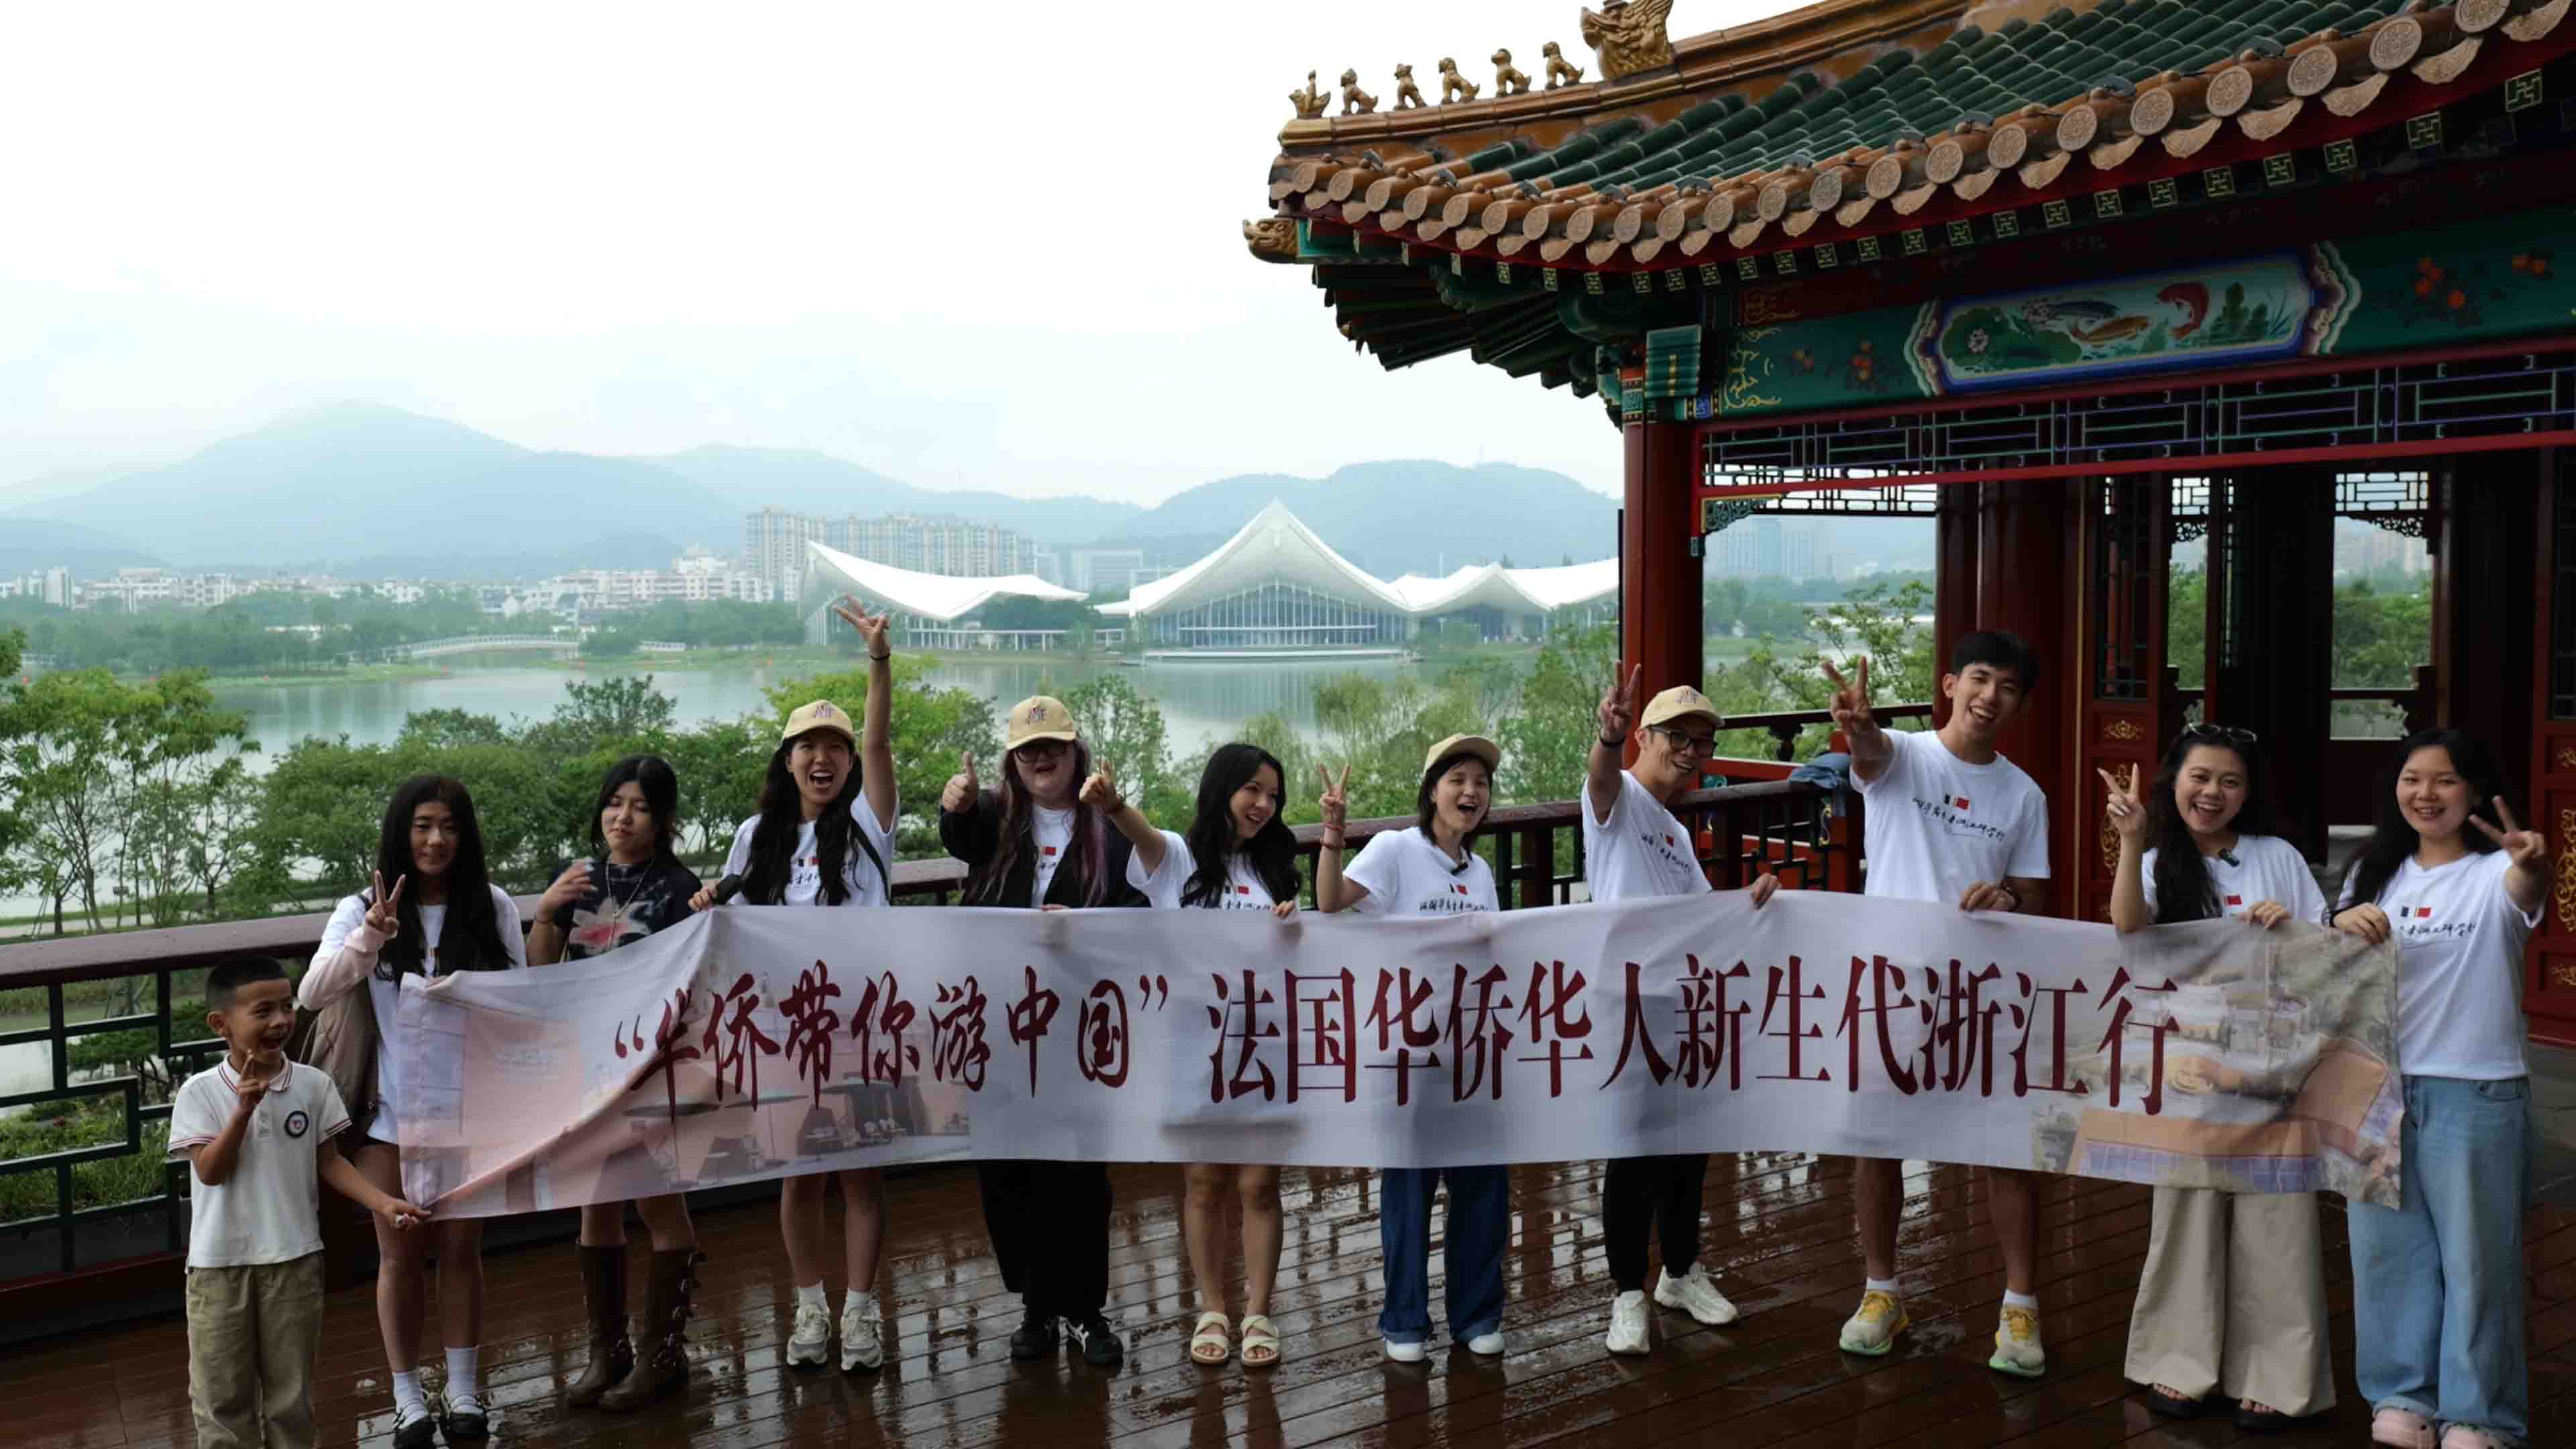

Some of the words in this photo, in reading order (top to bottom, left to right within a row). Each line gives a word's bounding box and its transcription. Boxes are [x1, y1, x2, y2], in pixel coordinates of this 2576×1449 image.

[1206, 953, 2180, 1116] 法国华侨华人新生代浙江行
